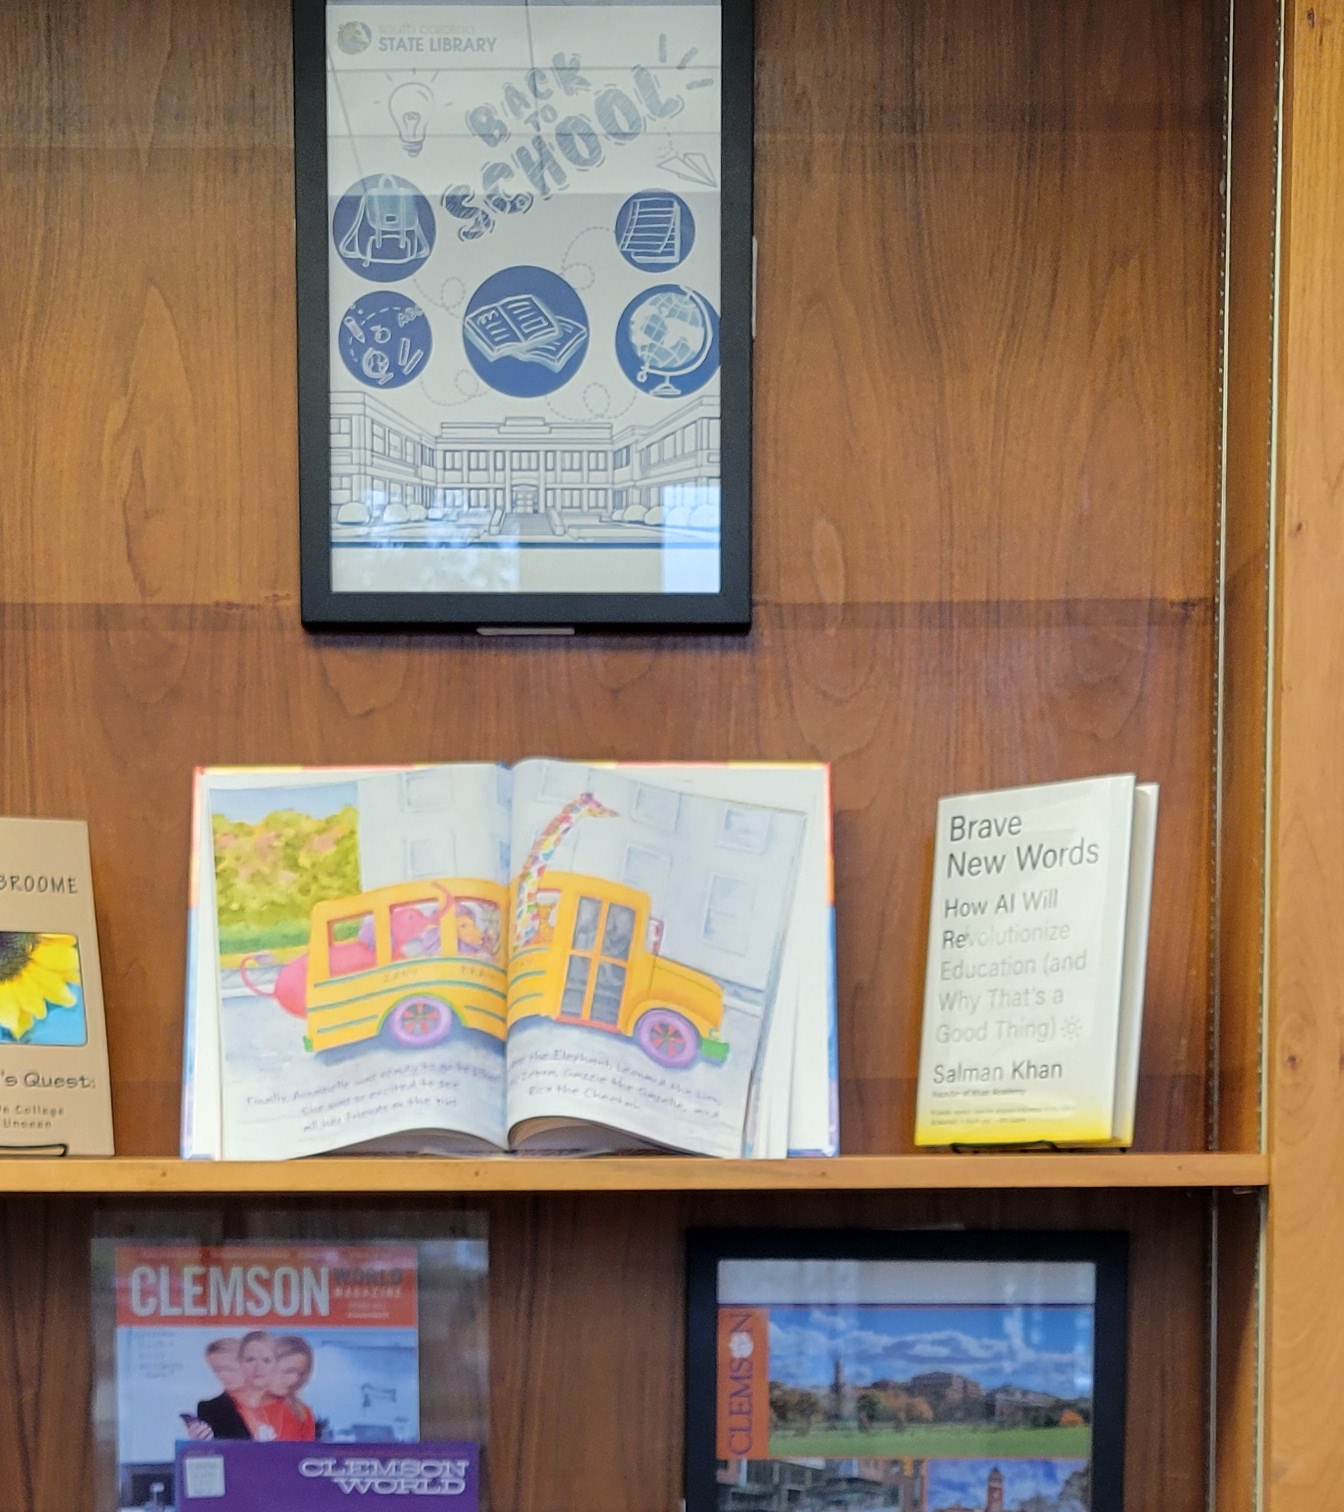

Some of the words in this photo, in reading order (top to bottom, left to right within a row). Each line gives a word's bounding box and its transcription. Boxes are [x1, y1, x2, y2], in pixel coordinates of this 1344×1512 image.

[379, 37, 424, 52] STATE
[430, 37, 497, 52] LIBRARY
[468, 53, 591, 148] BACK
[525, 108, 556, 131] TO
[443, 66, 685, 241] SCHOOL
[950, 815, 1022, 842] Brave
[947, 852, 1006, 878] New
[1016, 837, 1100, 872] Words
[944, 898, 988, 918] How
[995, 894, 1015, 914] AI
[1023, 889, 1058, 911] Will
[942, 922, 1070, 950] Revolutionize
[940, 957, 1036, 981] Education
[1043, 950, 1087, 977] (and
[938, 991, 980, 1014] Why
[988, 988, 1046, 1008] That's
[1052, 991, 1064, 1004] a
[936, 1022, 988, 1044] Good
[996, 1018, 1057, 1042] Thing)
[933, 1065, 1004, 1084] Salman
[1012, 1061, 1063, 1080] Khan
[3, 1118, 52, 1129] Unseen
[15, 1104, 65, 1118] College
[129, 1266, 330, 1318] CLEMSON
[333, 1268, 403, 1286] WORLD
[728, 1312, 754, 1458] CLEMSN
[298, 1457, 470, 1479] CLEMSON
[335, 1477, 467, 1496] WORLD
